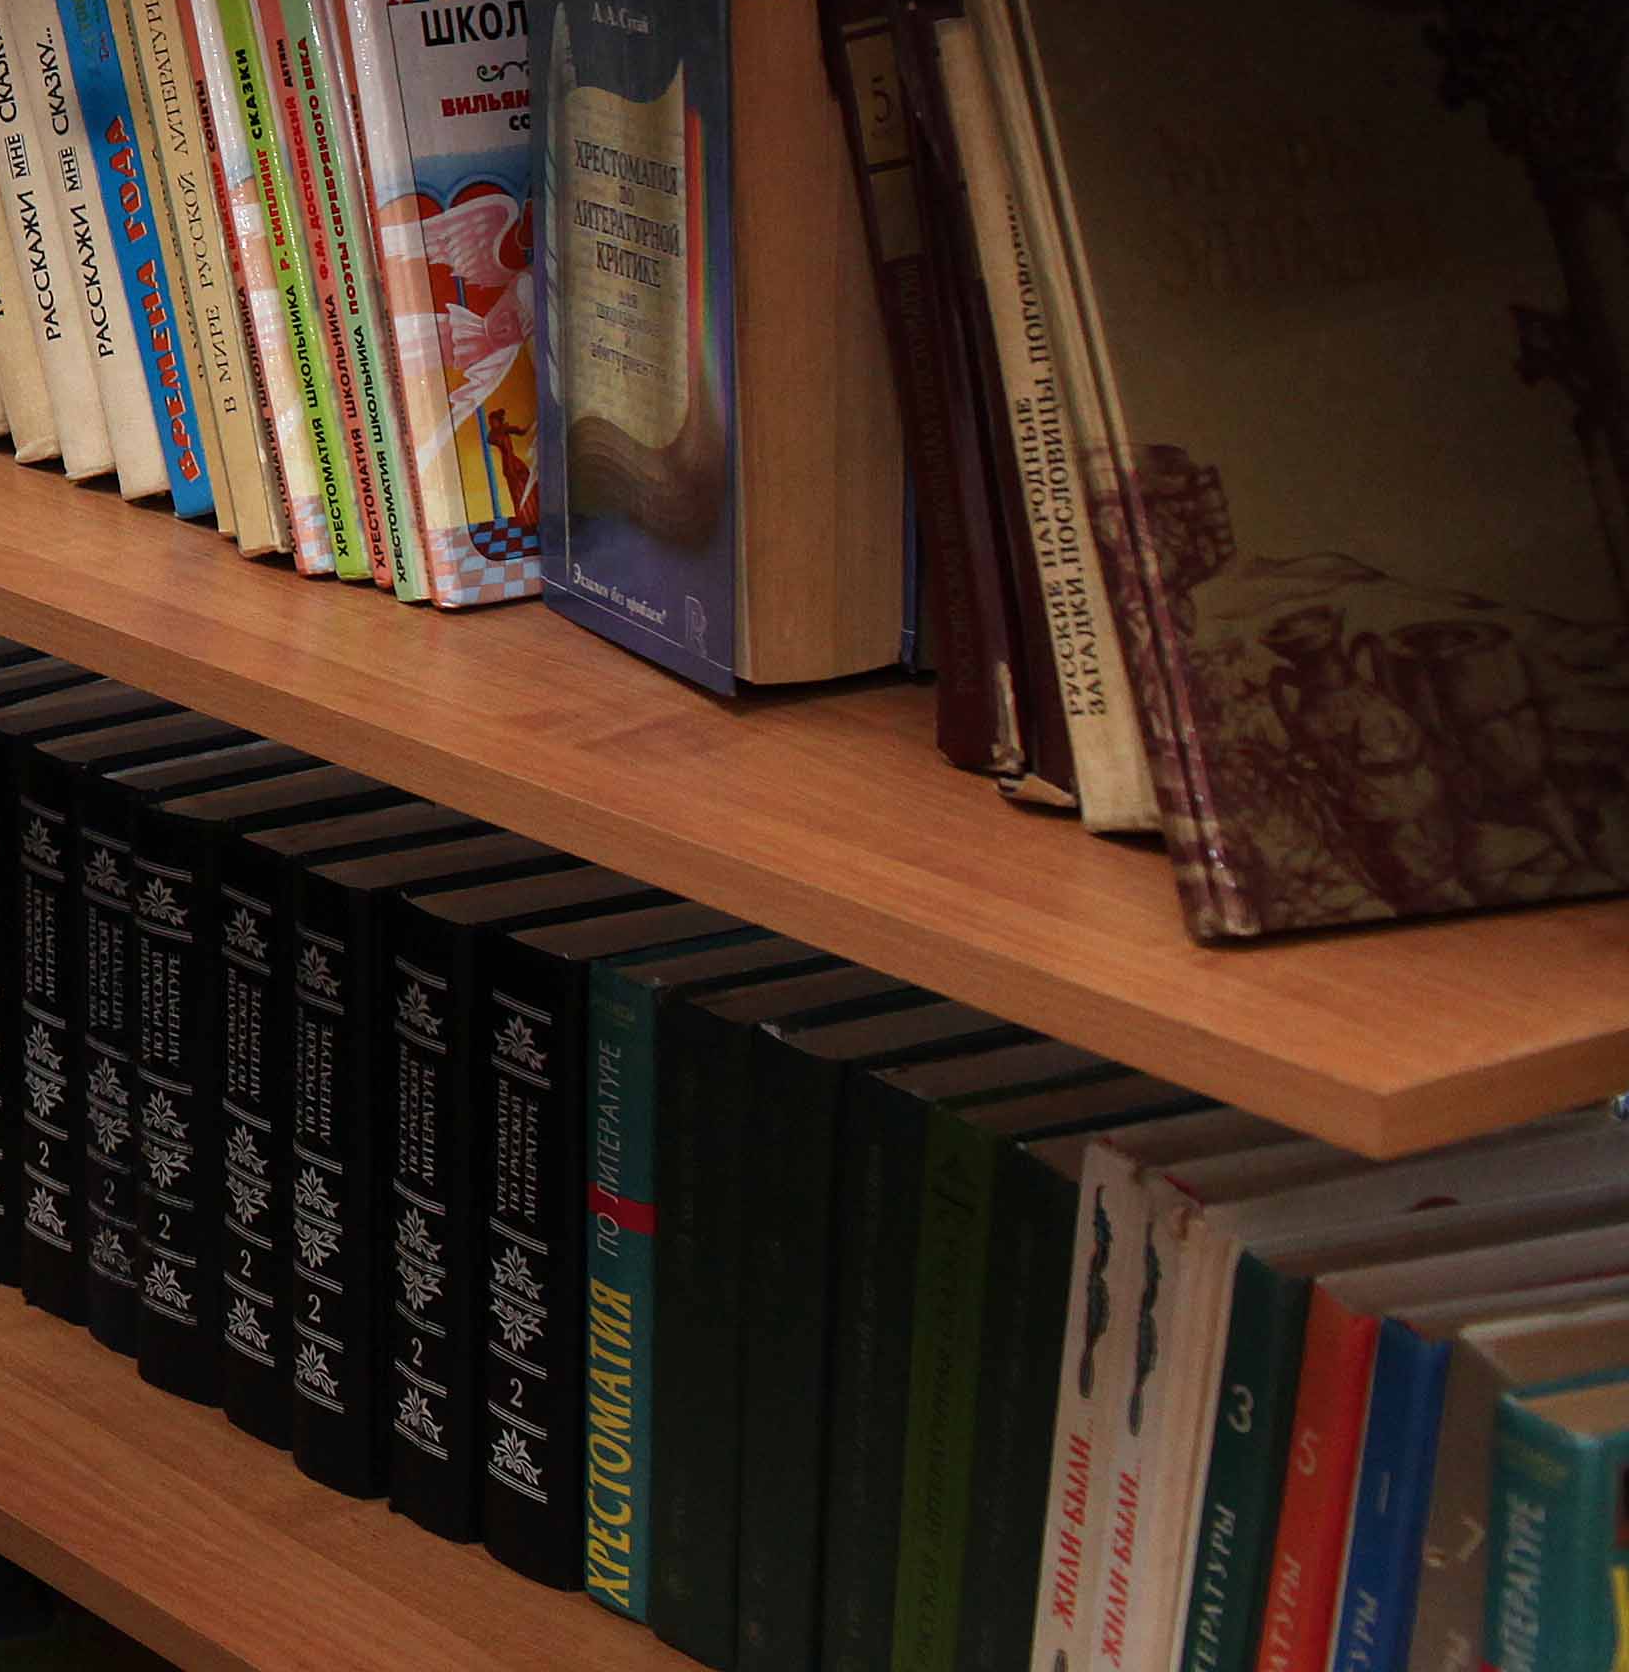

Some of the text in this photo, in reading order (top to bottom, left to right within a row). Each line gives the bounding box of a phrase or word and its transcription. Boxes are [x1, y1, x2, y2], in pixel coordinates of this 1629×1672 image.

[274, 38, 293, 89] ДЕТЯМ
[296, 36, 316, 90] ВЕКА
[420, 0, 529, 48] ШКОЛ
[4, 133, 30, 179] МНЕ
[33, 26, 115, 358] РАССКАЖИ МНЕ СКАЗКУ...
[97, 113, 152, 243] ГОДА
[284, 94, 321, 232] ДОСТОЕВСКИЙ
[307, 93, 345, 238] СЕРЕБРЯНОГО
[573, 139, 679, 196] ХРЕСТОМАТИЯ
[13, 190, 66, 341] РАССКАЖИ
[175, 170, 215, 290] РУССКОЙ
[336, 240, 359, 315] ПОЭТЫ
[572, 199, 681, 258] ЛИТЕРАТУРНОЙ
[595, 239, 662, 289] КРИТИКЕ
[204, 304, 232, 382] МИРЕ
[234, 47, 349, 557] ХРЕСТОМАТИЯ ШКОЛЬНИКА Р. КИПЛИНГ СКАЗКИ
[323, 293, 358, 419] ШКОЛЬНИКА
[131, 258, 205, 483] ВРЕМЕНА
[220, 395, 237, 413] В
[351, 324, 383, 444] ШКОЛЬНИКА
[349, 427, 387, 569] ХРЕСТОМАТИЯ
[374, 449, 408, 583] ХРЕСТОМАТИЯ
[1013, 395, 1084, 718] РУССКИЕ НАРОДНЫЕ
[237, 982, 247, 1059] РУССКОЙ
[249, 985, 261, 1102] ЛИТЕРАТУРЕ
[495, 1077, 509, 1212] ХРЕСТОМАТИЯ
[509, 1095, 521, 1210] ПО РУССКОЙ
[523, 1096, 538, 1222] ЛИТЕРАТУРЕ
[594, 1039, 624, 1202] ЛИТЕРАТУРЕ
[596, 1208, 621, 1258] ПО
[586, 1275, 635, 1608] ХРЕСТОМАТИЯ
[1044, 1416, 1099, 1632] ЖИЛИ-БЫЛИ...
